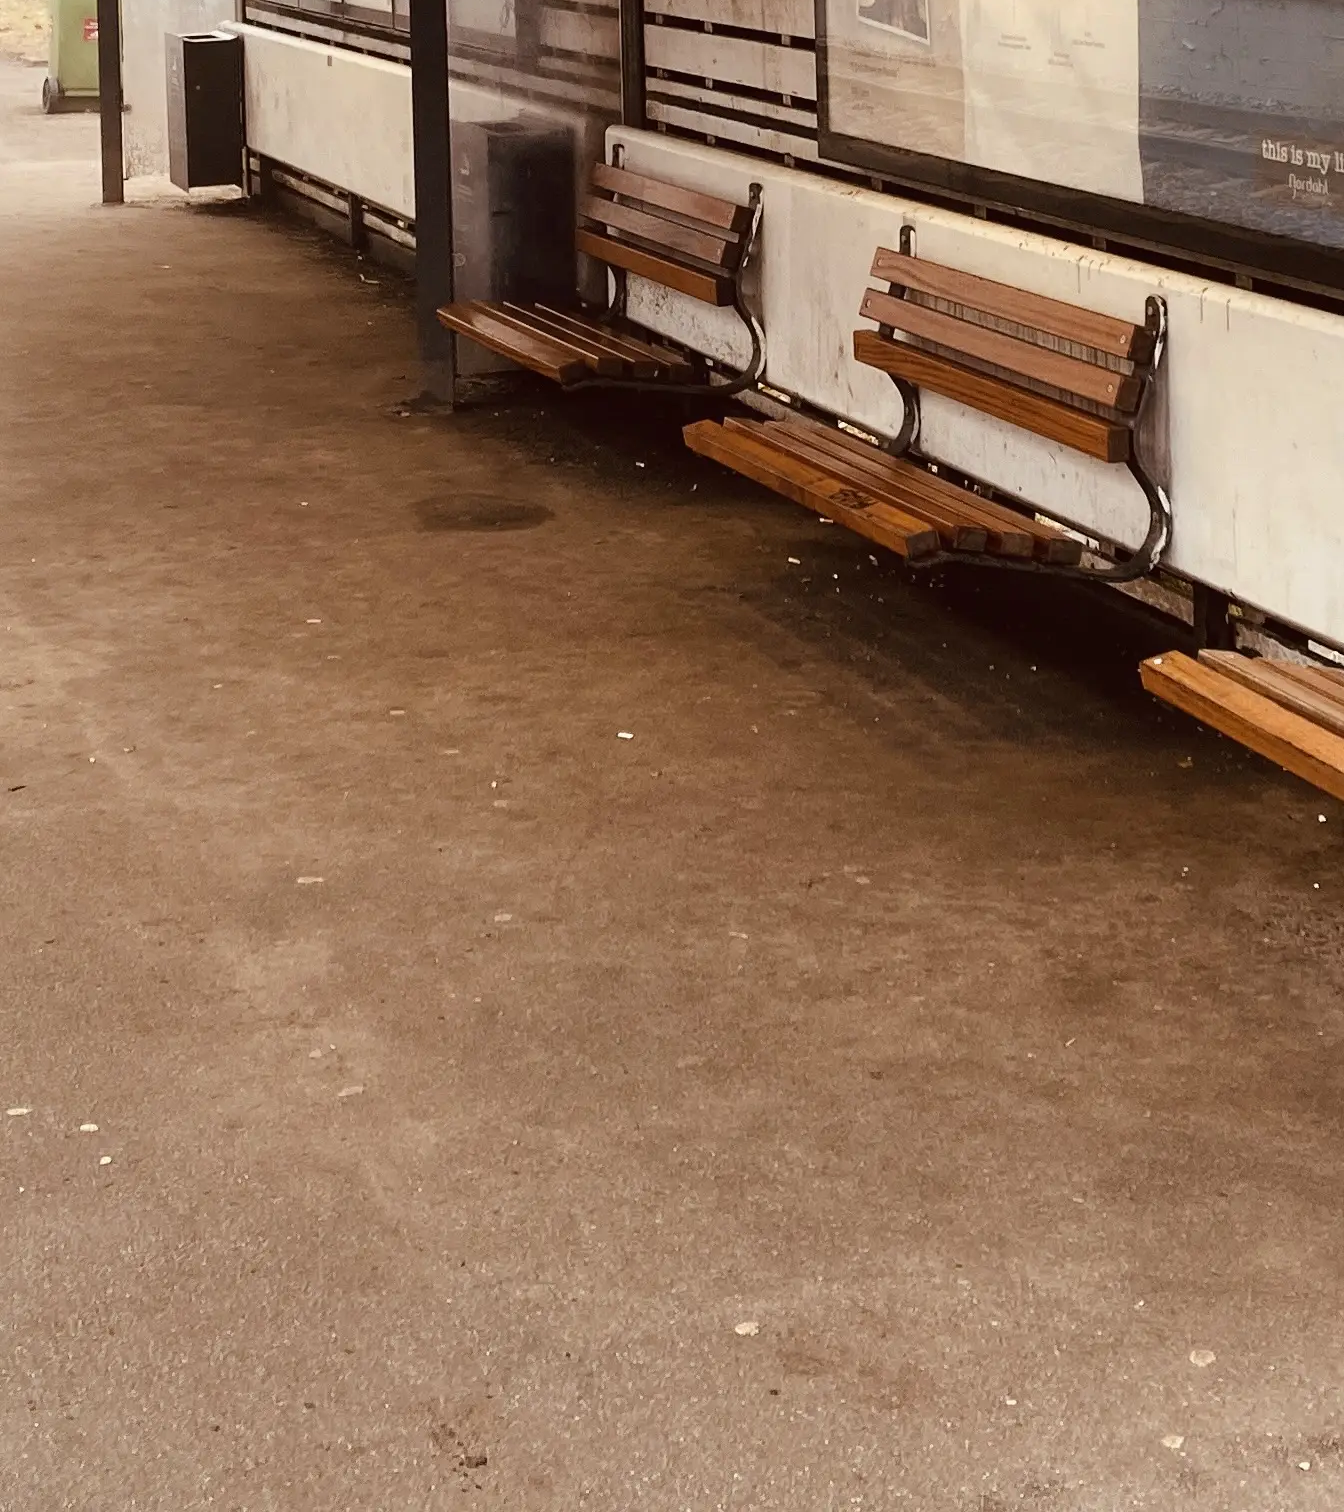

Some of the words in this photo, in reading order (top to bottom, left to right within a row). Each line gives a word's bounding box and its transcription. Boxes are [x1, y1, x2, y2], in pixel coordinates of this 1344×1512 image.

[1262, 139, 1288, 163] this
[1290, 145, 1304, 166] is
[1306, 150, 1331, 175] my
